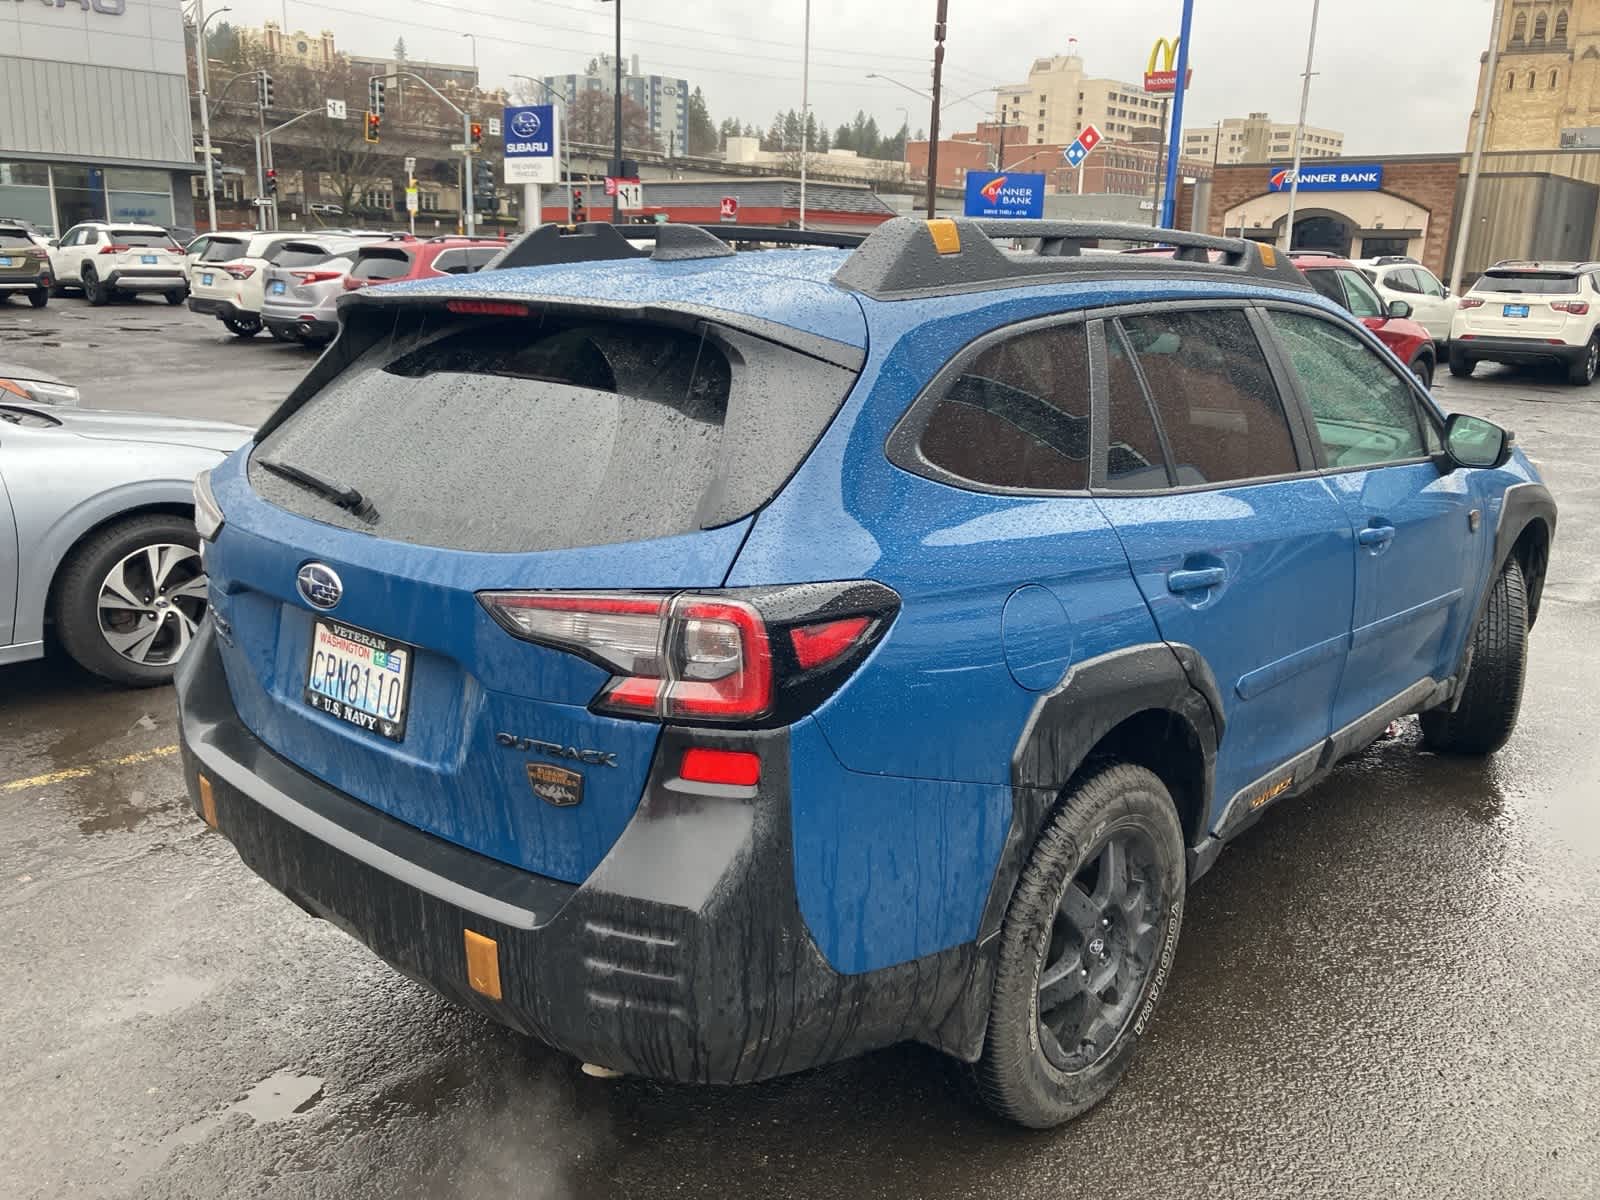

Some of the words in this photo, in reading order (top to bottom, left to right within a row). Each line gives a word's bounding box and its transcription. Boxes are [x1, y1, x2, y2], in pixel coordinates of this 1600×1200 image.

[506, 142, 548, 152] SUBARU
[1341, 172, 1378, 183] BANK
[988, 187, 1033, 197] BANNER
[1002, 196, 1032, 205] BANK
[320, 631, 370, 659] WASHINGTON
[332, 624, 386, 650] VETERAN
[312, 650, 401, 719] CRN8110
[343, 706, 377, 730] NAVY
